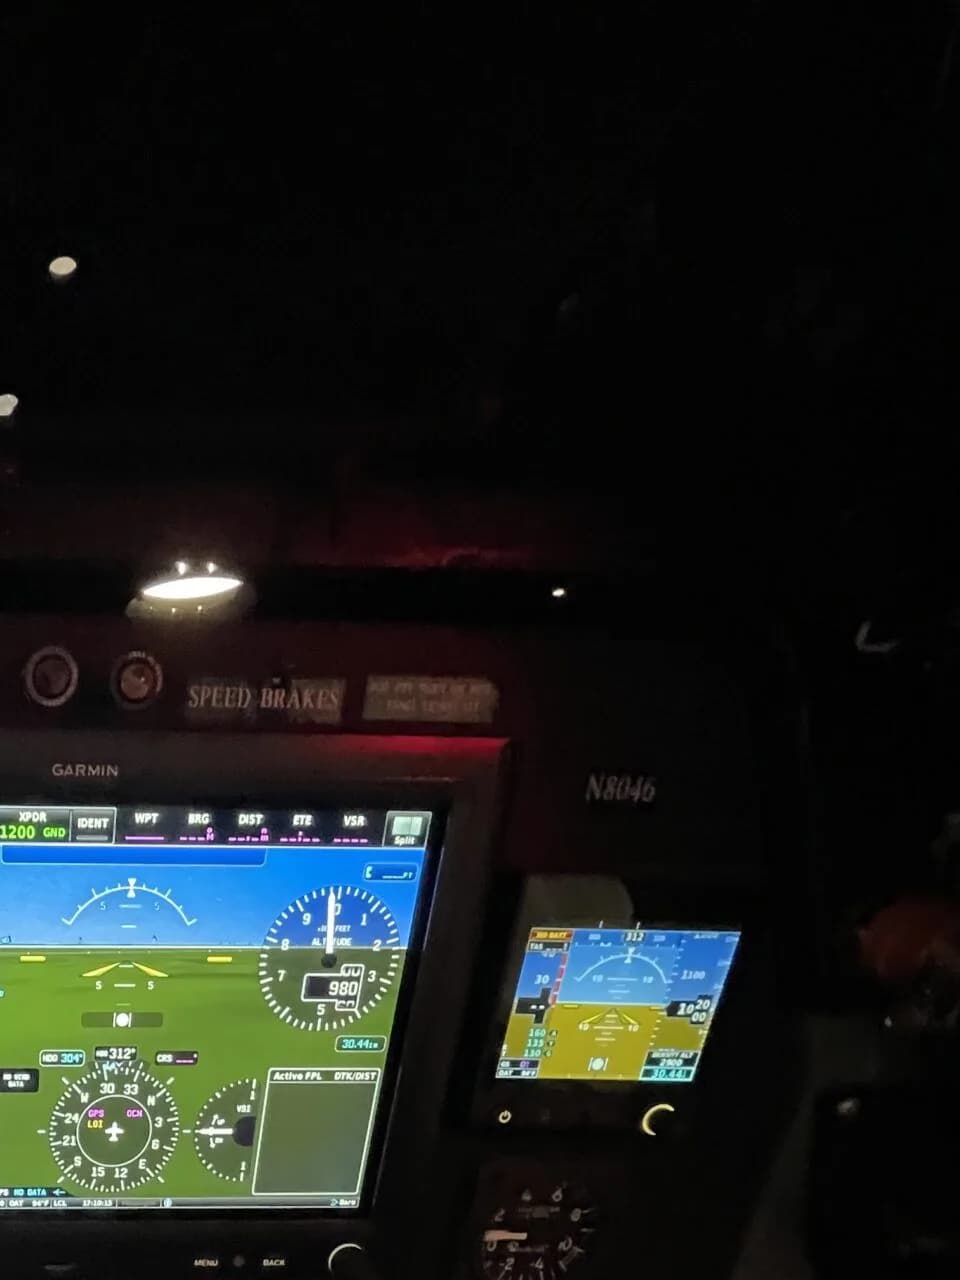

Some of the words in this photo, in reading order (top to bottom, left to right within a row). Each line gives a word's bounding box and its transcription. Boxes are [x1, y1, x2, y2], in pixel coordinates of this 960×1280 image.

[189, 685, 252, 708] SPEED
[260, 687, 340, 709] BRAKES
[52, 763, 119, 777] GARMIN
[18, 811, 47, 822] XPDR
[134, 812, 159, 824] WPT
[187, 813, 210, 824] BRG
[238, 813, 263, 825] DIST
[293, 814, 313, 825] ETE
[343, 815, 365, 826] VSR
[77, 818, 109, 829] IDENT
[0, 824, 36, 839] 1200
[43, 827, 66, 838] GND
[394, 836, 416, 846] Split
[302, 913, 311, 925] 9
[361, 913, 367, 926] 1
[625, 932, 644, 942] 312
[281, 939, 290, 951] 8
[372, 939, 382, 951] 2
[278, 969, 286, 981] 7
[367, 970, 377, 982] 3
[95, 981, 102, 990] 5
[147, 981, 154, 990] 5
[328, 981, 359, 996] 980
[316, 1003, 326, 1016] 5
[677, 1002, 695, 1016] 10
[695, 999, 711, 1010] 20
[691, 1011, 707, 1023] 00
[60, 1053, 83, 1063] 304°
[109, 1048, 136, 1059] 312°
[156, 1054, 173, 1063] CRS
[273, 1072, 303, 1081] Active
[304, 1072, 322, 1081] FPL
[334, 1072, 376, 1081] DTK/DIST
[100, 1083, 115, 1094] 30
[123, 1084, 138, 1095] 33
[80, 1092, 88, 1103] W
[147, 1095, 155, 1106] N
[64, 1113, 79, 1124] 24
[88, 1109, 104, 1118] GPS
[87, 1119, 103, 1128] LOI
[154, 1116, 163, 1128] 3
[62, 1135, 76, 1146] 21
[151, 1139, 159, 1150] 6
[74, 1156, 82, 1167] S
[139, 1159, 146, 1169] E
[91, 1167, 105, 1177] 15
[114, 1168, 128, 1178] 12
[27, 1188, 47, 1196] DATA
[194, 1258, 219, 1267] MENU
[263, 1258, 286, 1267] BACK
